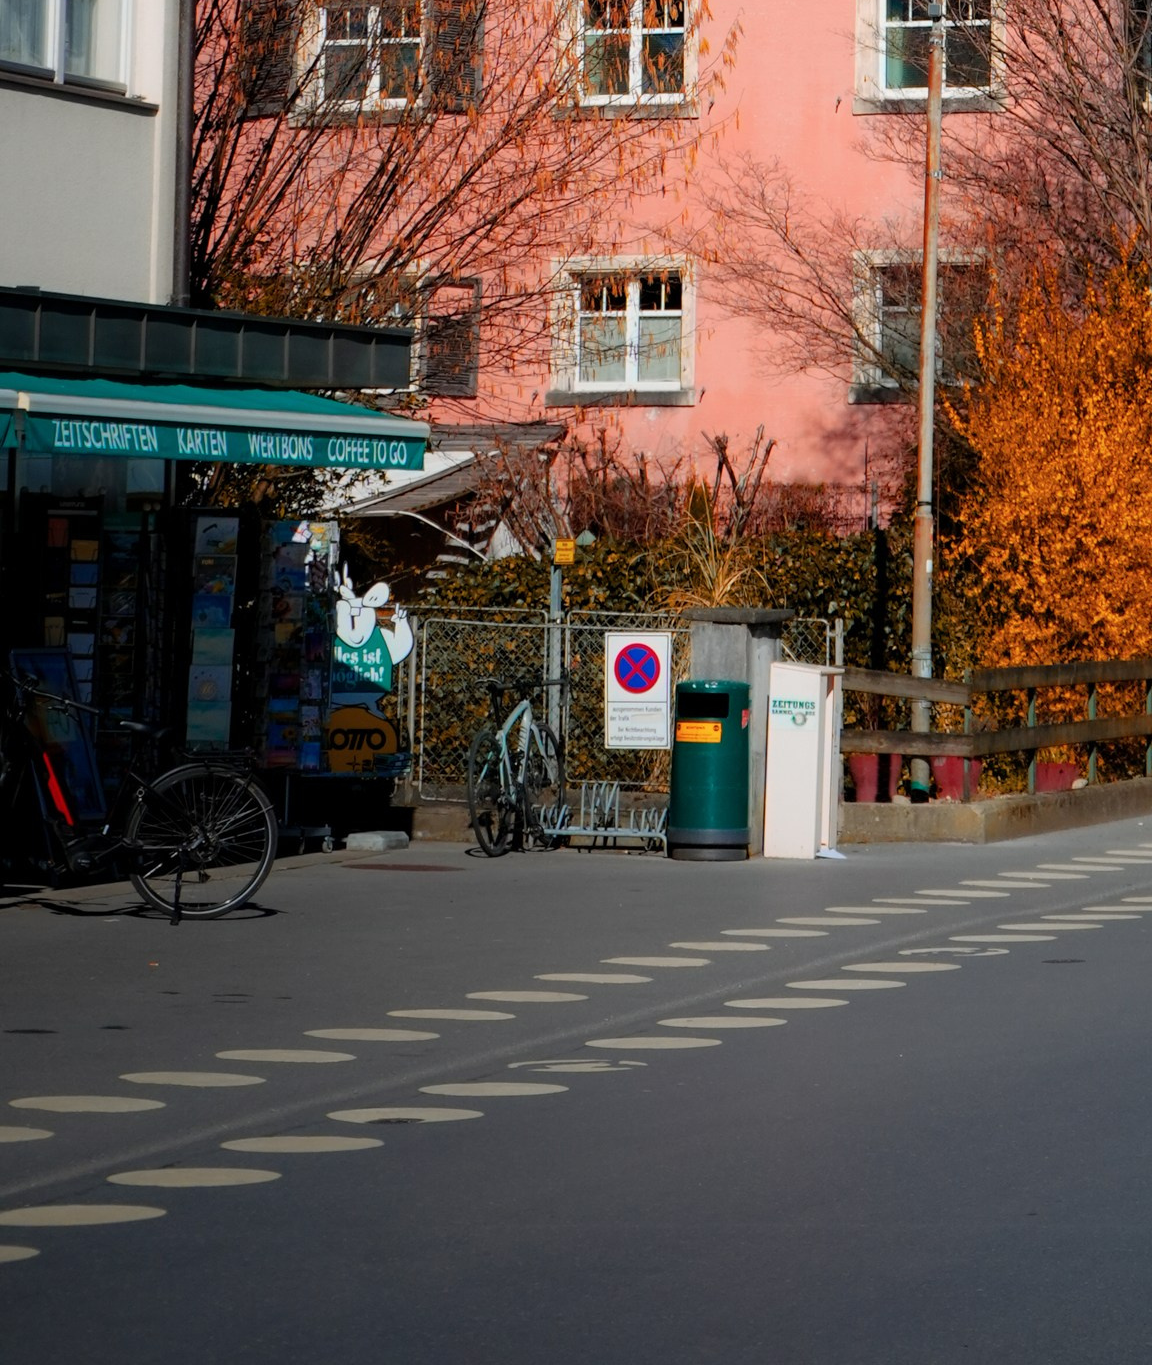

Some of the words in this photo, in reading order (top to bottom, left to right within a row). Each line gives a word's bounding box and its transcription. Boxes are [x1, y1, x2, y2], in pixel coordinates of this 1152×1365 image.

[52, 418, 158, 452] ZEITSCHRIFTEN
[177, 427, 227, 456] KARTEN
[248, 430, 313, 460] WERTBONS
[328, 436, 369, 463] COFFEE
[372, 439, 387, 464] TO
[389, 439, 407, 465] GO
[334, 646, 360, 665] lles
[363, 648, 383, 665] ist
[334, 665, 384, 690] öglich!
[772, 700, 816, 710] ZEITUNGS
